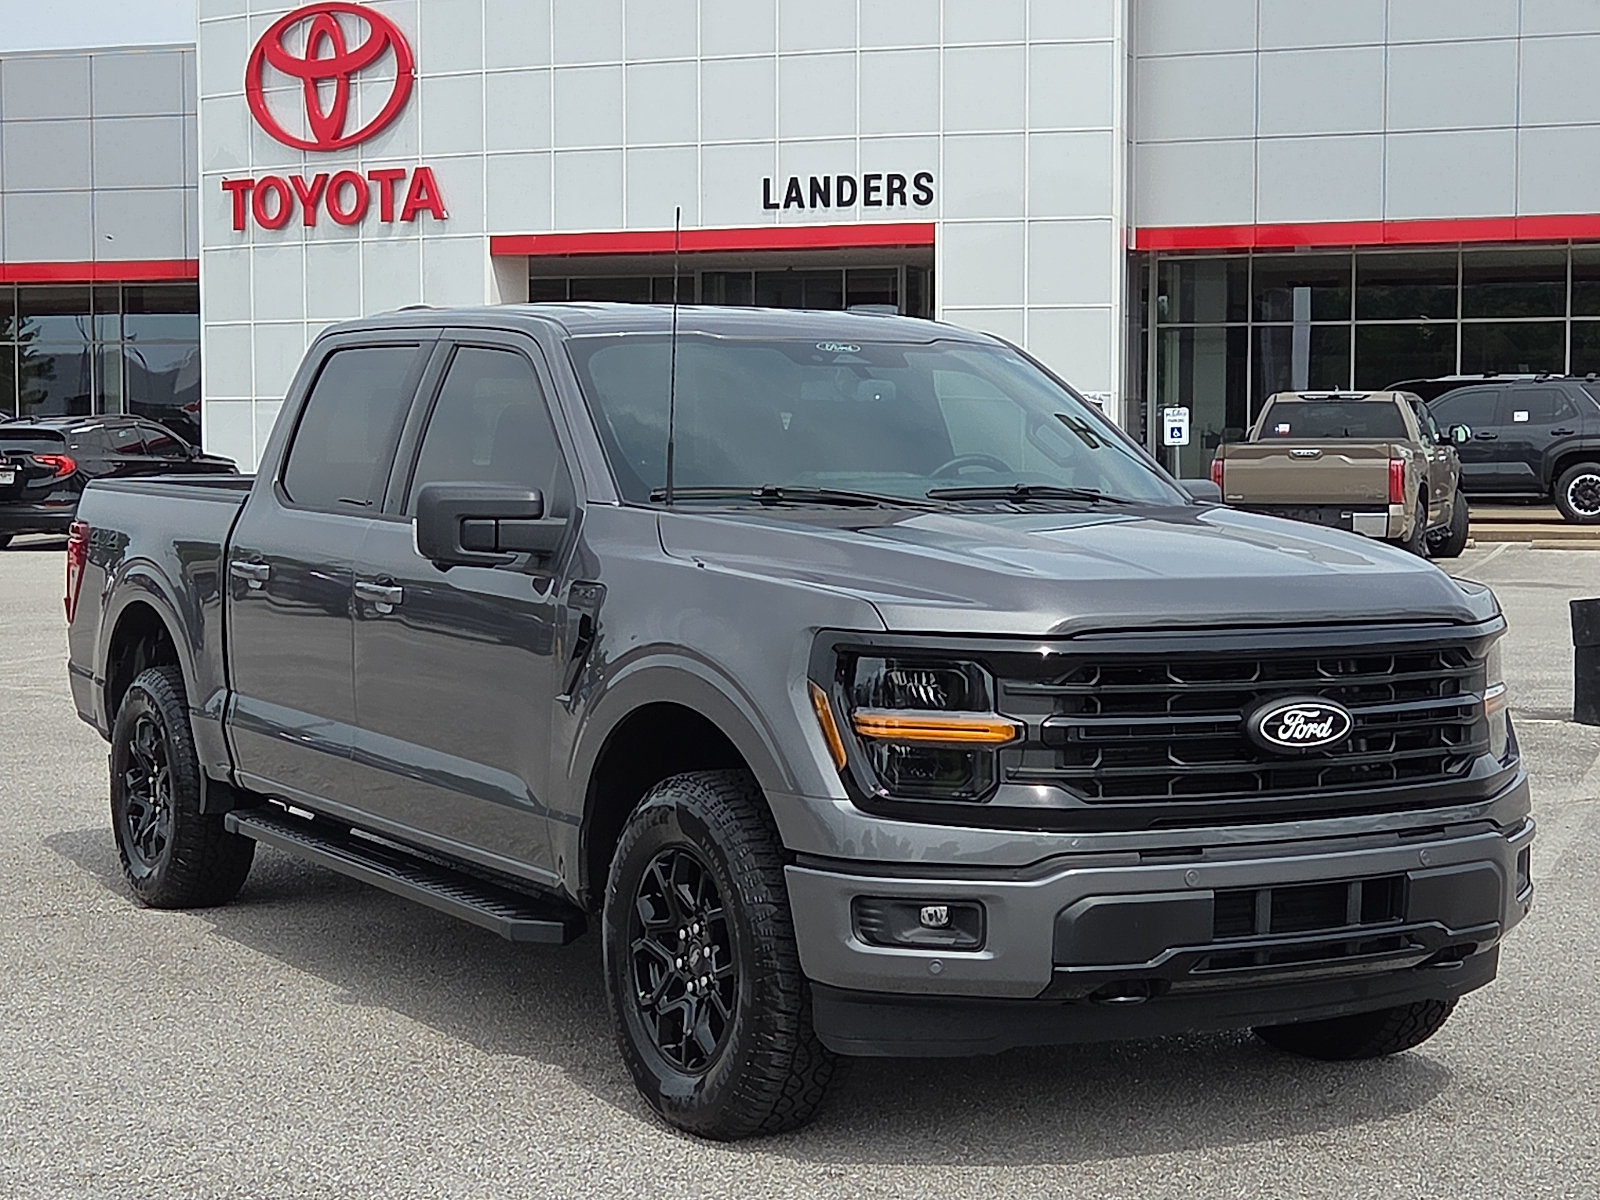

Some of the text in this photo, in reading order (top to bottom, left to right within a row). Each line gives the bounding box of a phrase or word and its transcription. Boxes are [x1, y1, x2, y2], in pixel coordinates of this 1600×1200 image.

[222, 166, 448, 231] TOYOTA
[763, 172, 934, 209] LANDERS
[1278, 710, 1334, 740] Ford
